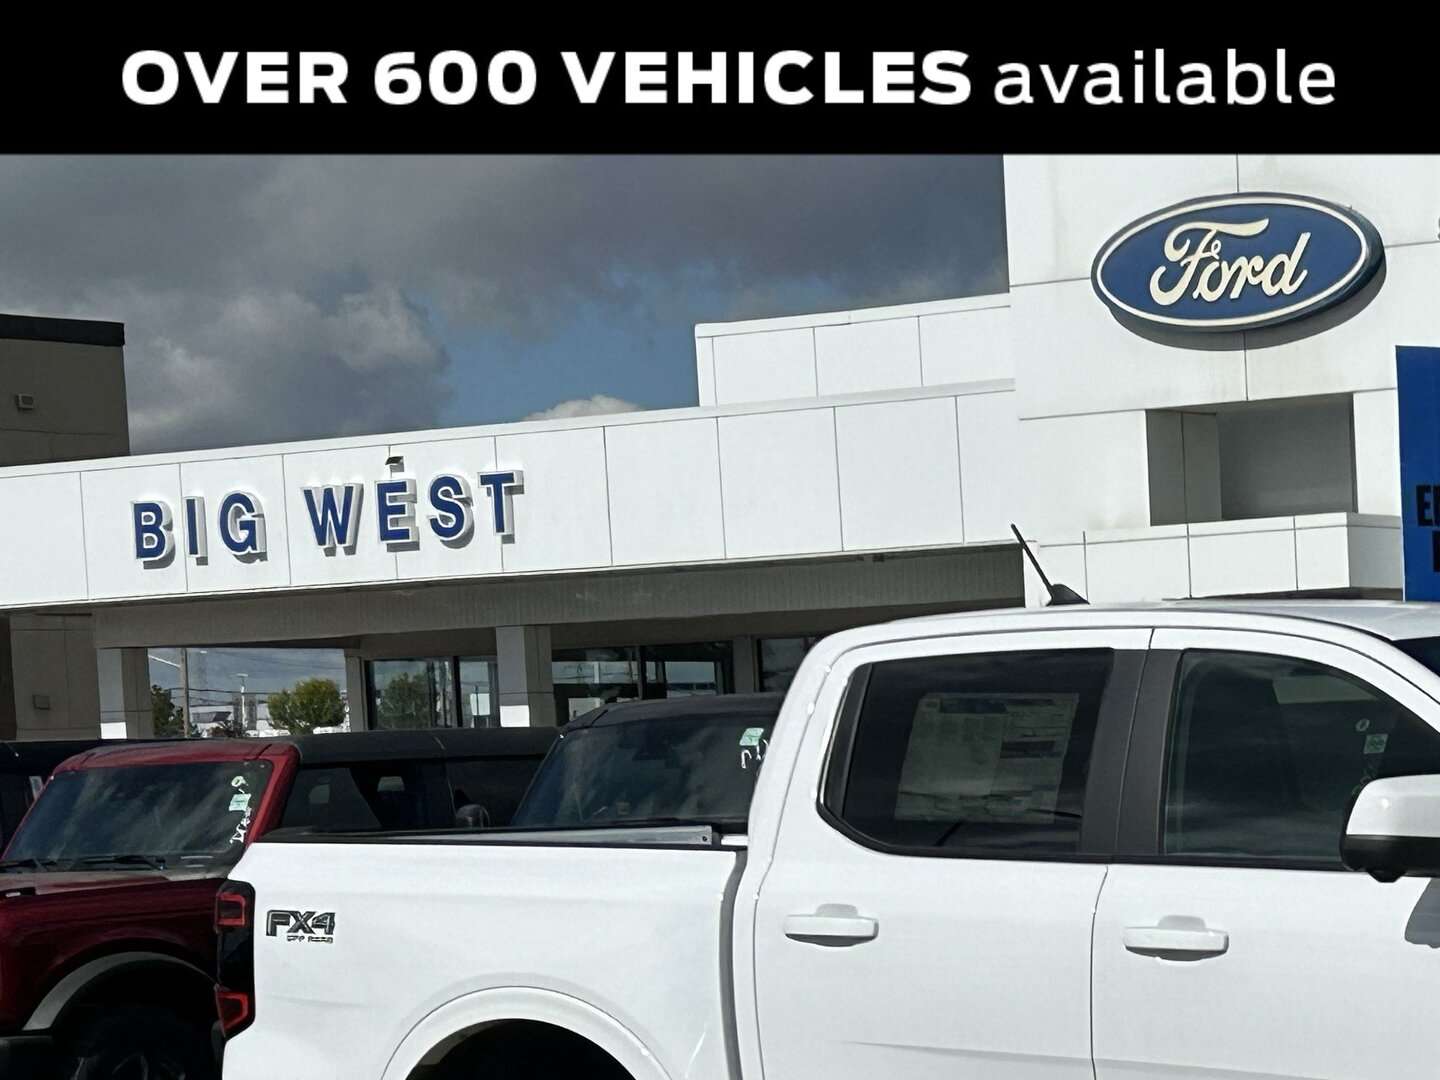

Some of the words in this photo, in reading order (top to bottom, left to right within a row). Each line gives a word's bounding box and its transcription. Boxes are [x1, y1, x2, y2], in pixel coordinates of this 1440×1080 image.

[1150, 217, 1312, 306] Ford
[133, 491, 268, 562] BIG
[302, 471, 524, 556] WEST
[266, 909, 336, 937] FX4
